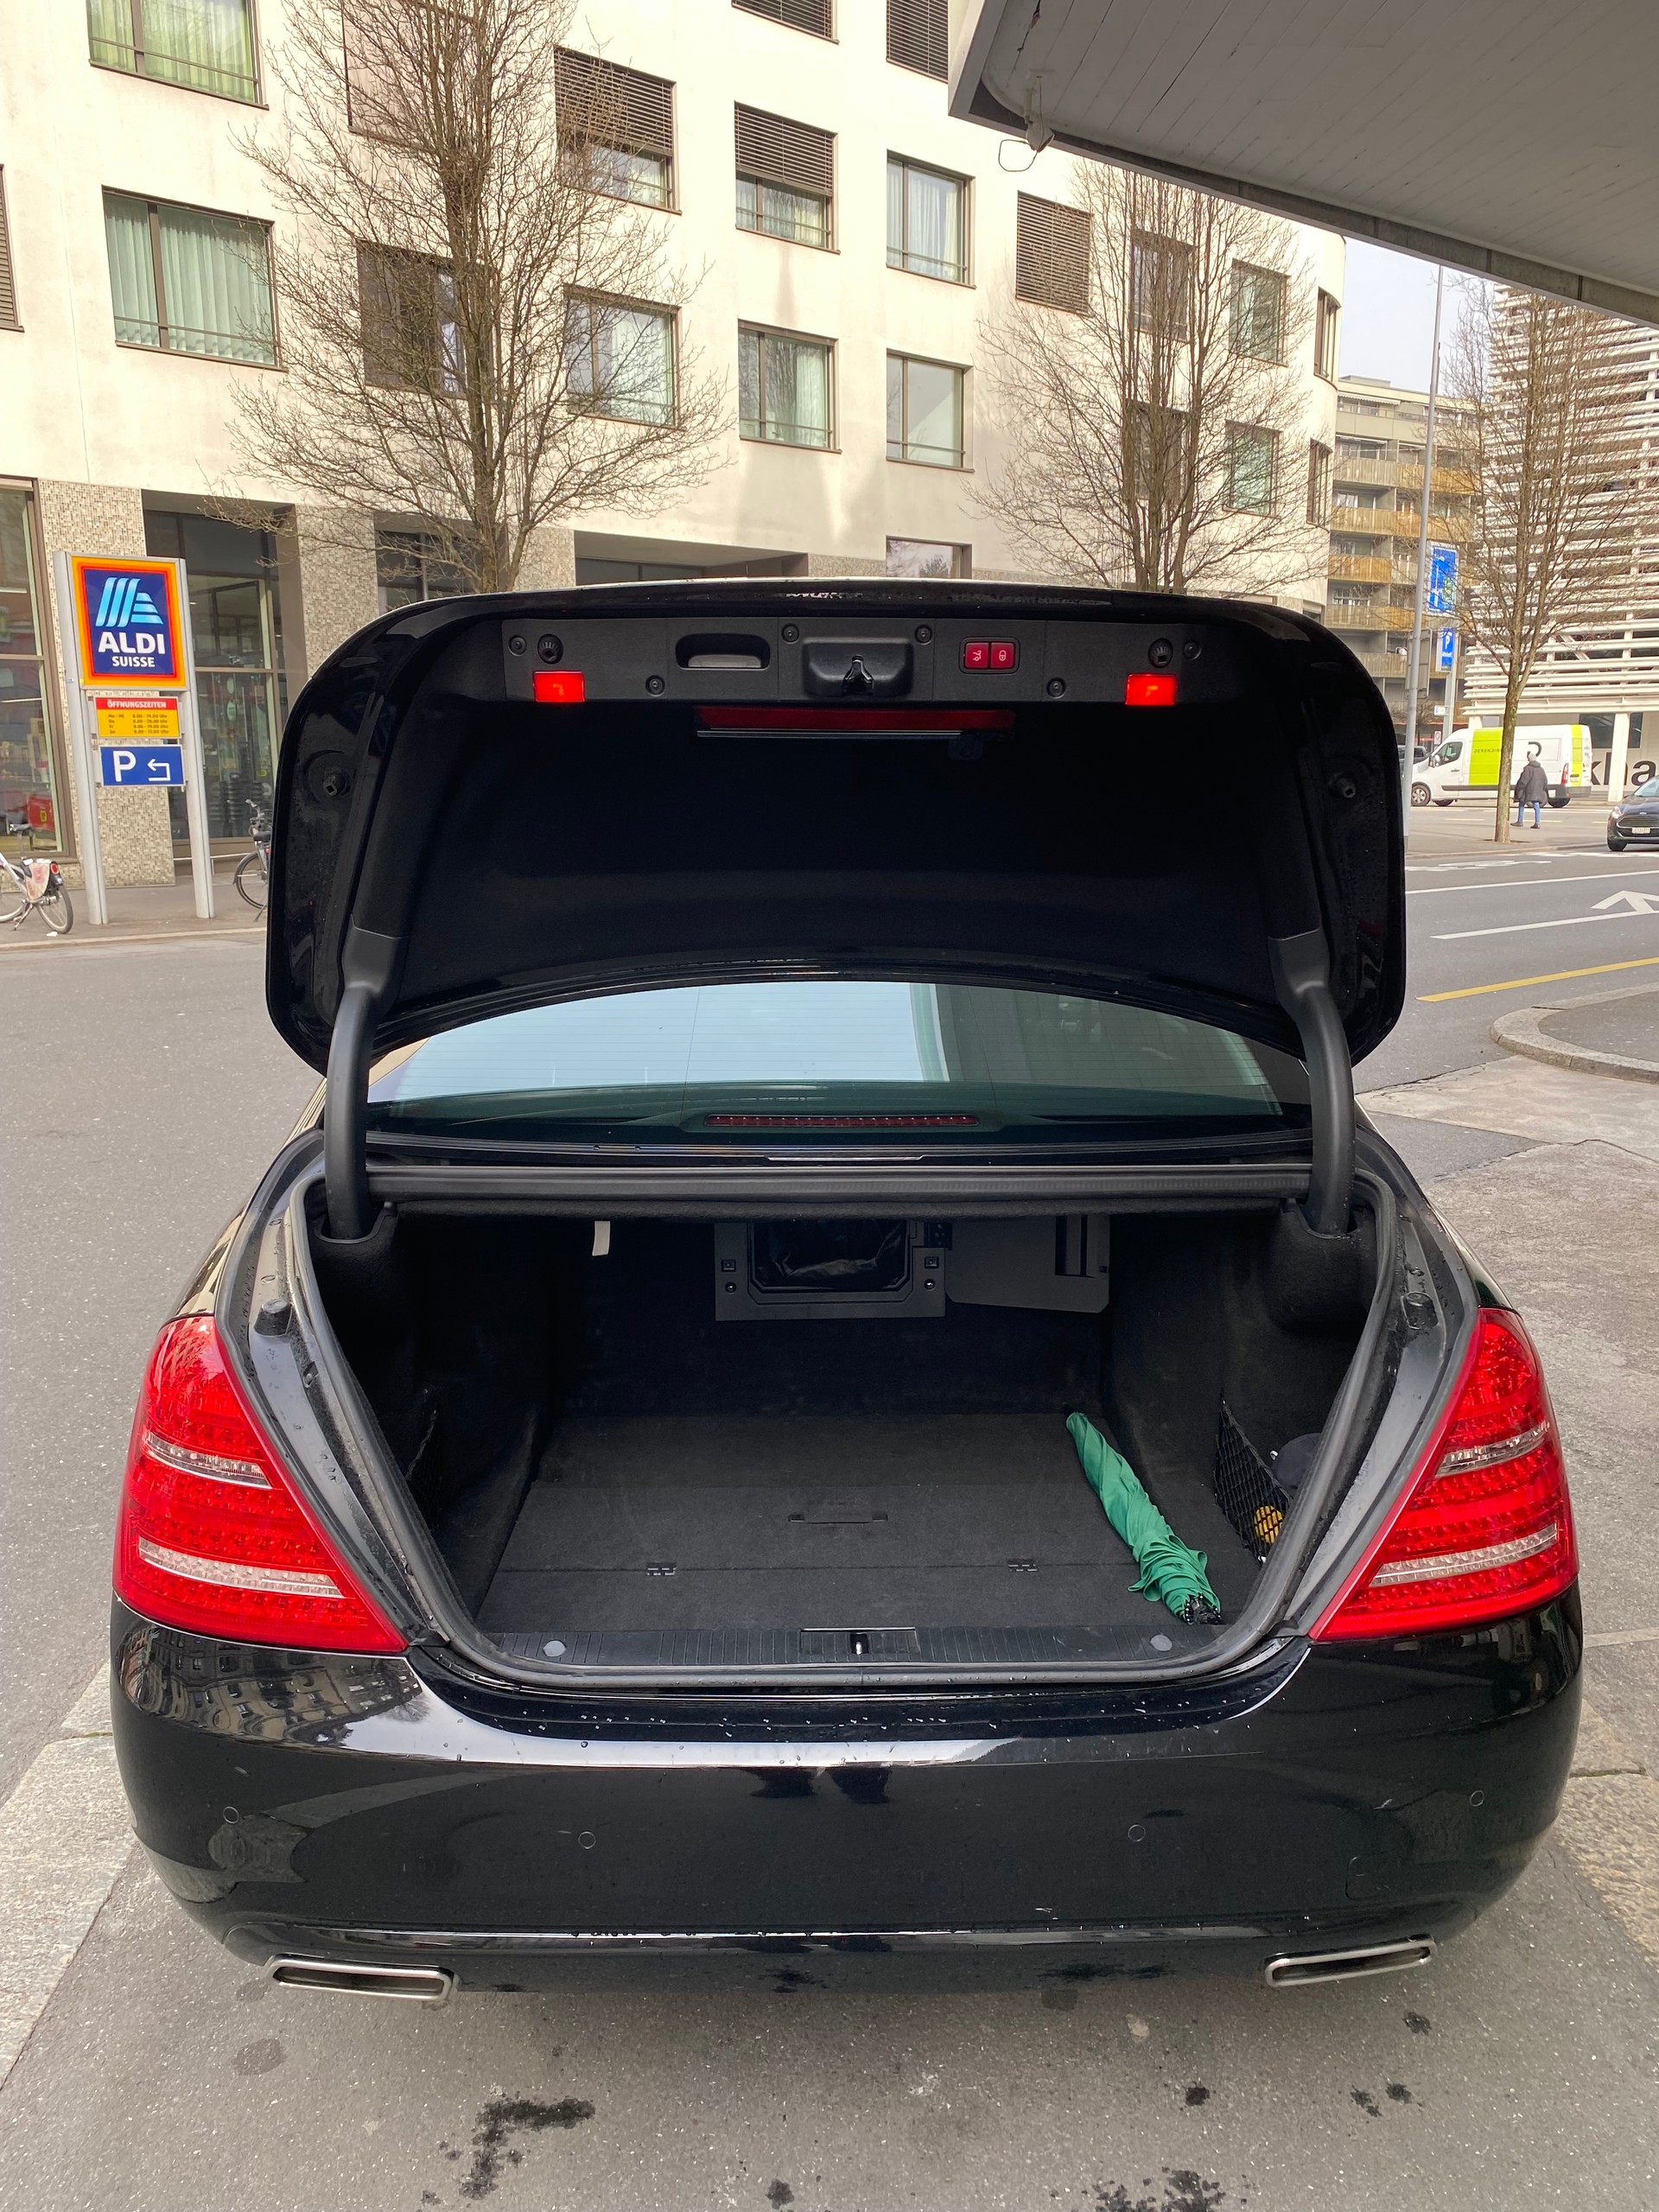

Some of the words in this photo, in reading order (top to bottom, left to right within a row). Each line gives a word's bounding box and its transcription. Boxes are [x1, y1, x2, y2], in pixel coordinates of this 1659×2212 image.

[98, 631, 166, 654] ALDI
[1445, 635, 1451, 650] P
[111, 655, 156, 668] SUISSE
[106, 698, 167, 709] ÖFFNUNGSZEITEN
[112, 750, 137, 782] P
